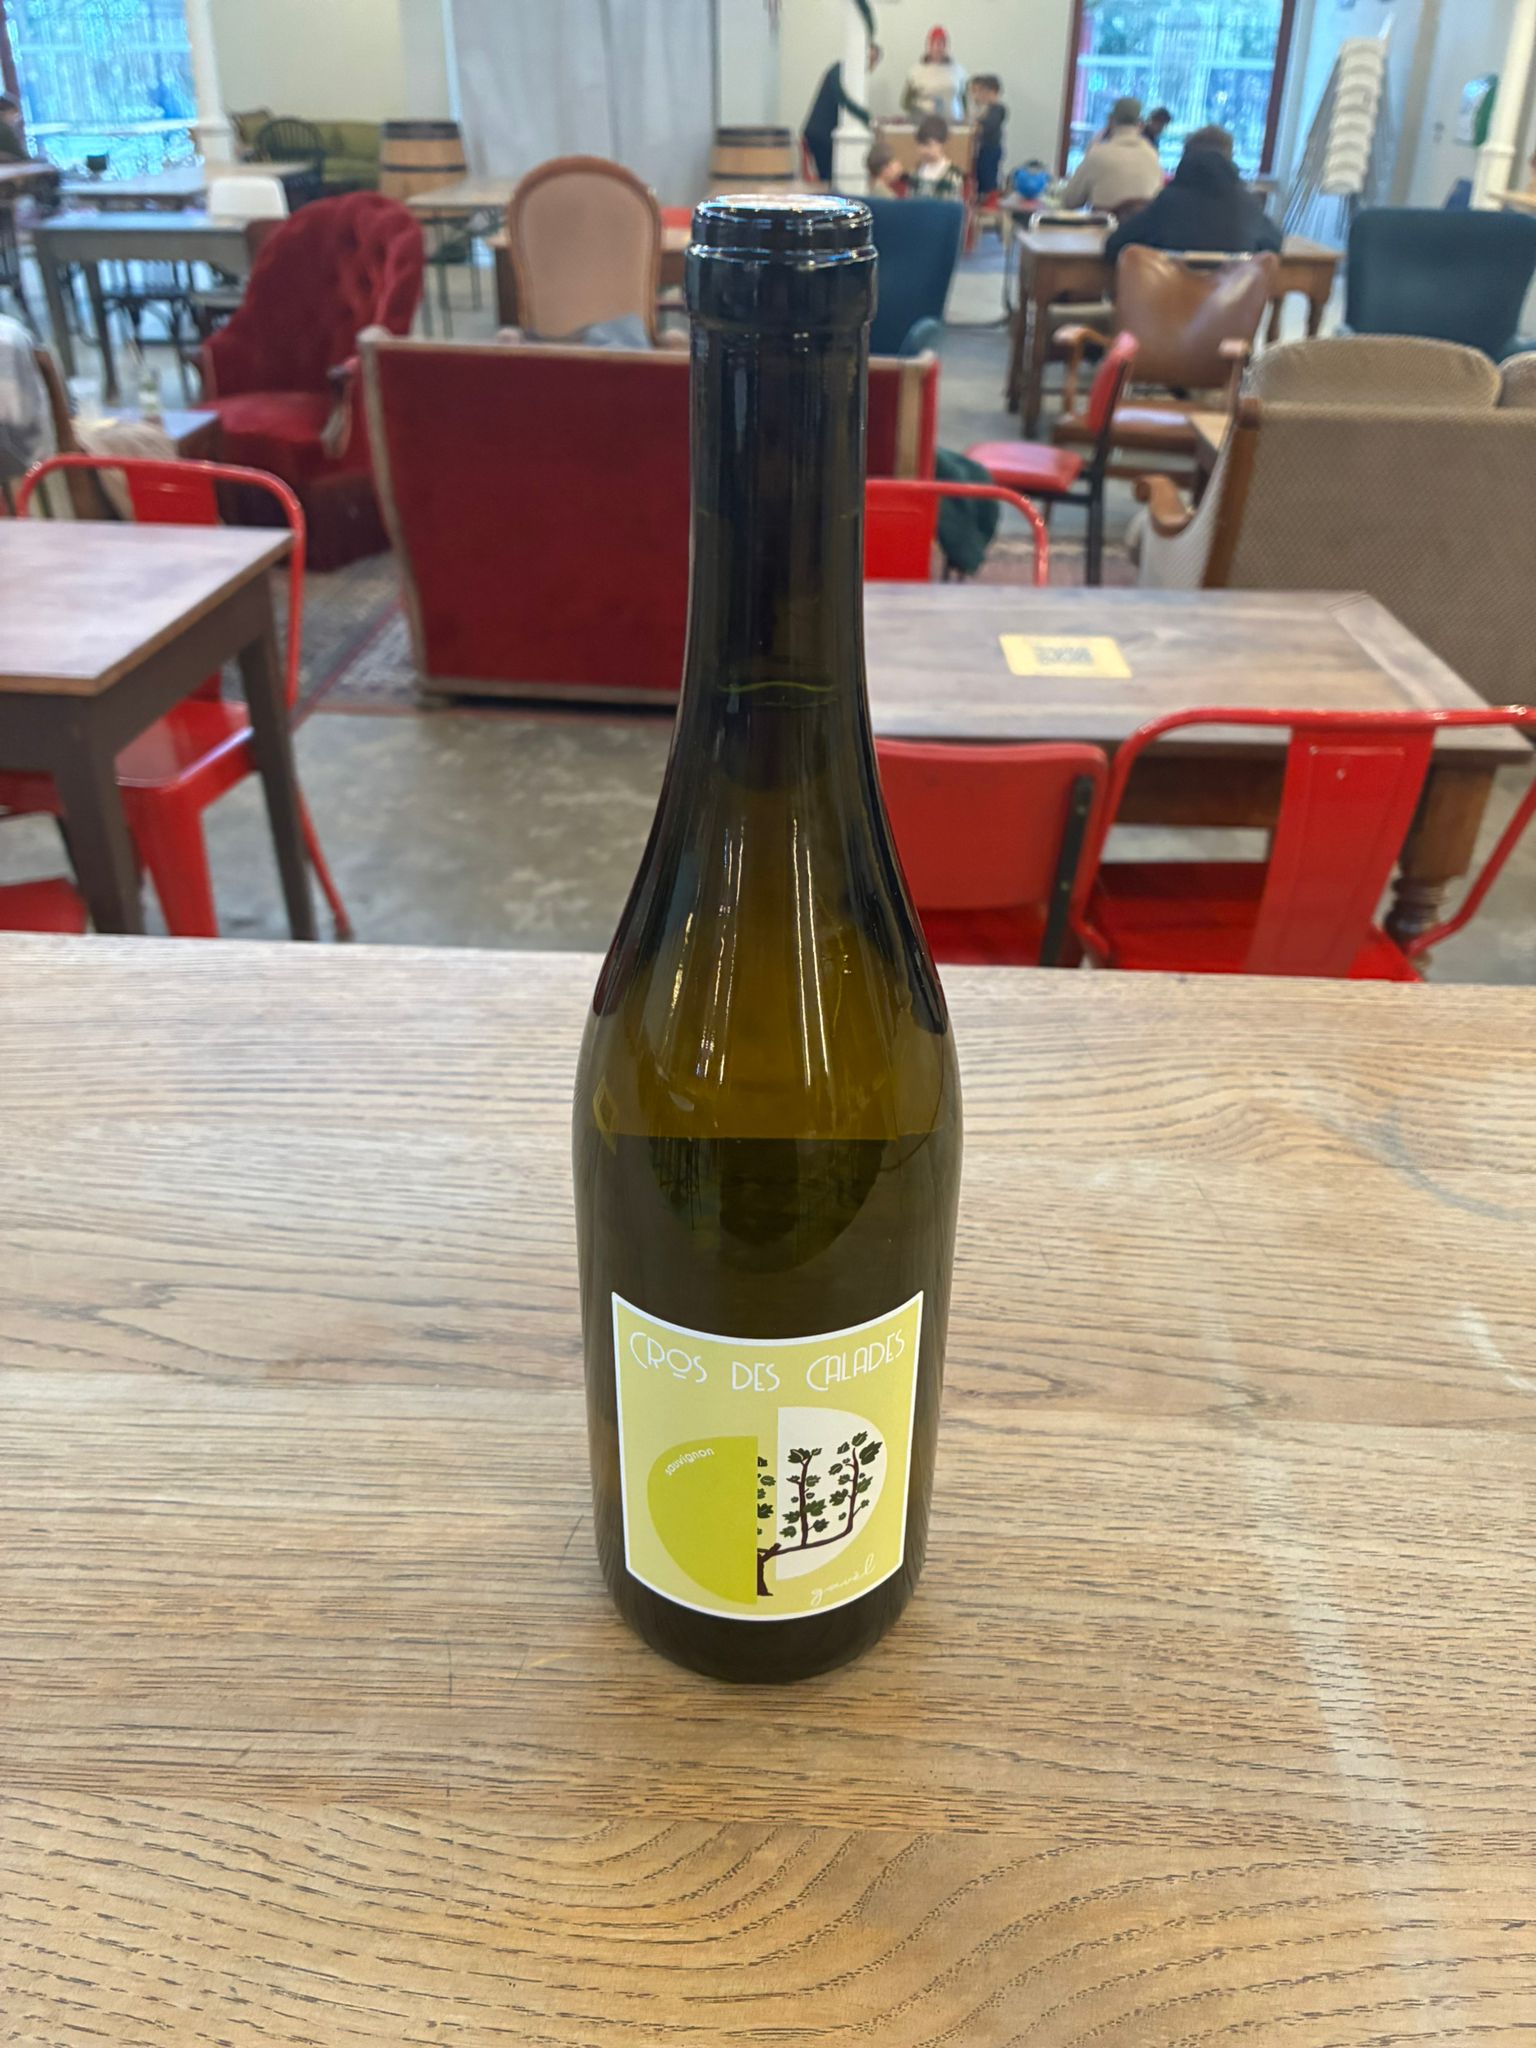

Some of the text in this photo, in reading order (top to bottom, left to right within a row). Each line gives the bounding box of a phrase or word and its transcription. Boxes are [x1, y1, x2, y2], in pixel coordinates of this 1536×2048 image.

[630, 1330, 905, 1391] CROS DES CALADES
[665, 1448, 714, 1476] sauvignon
